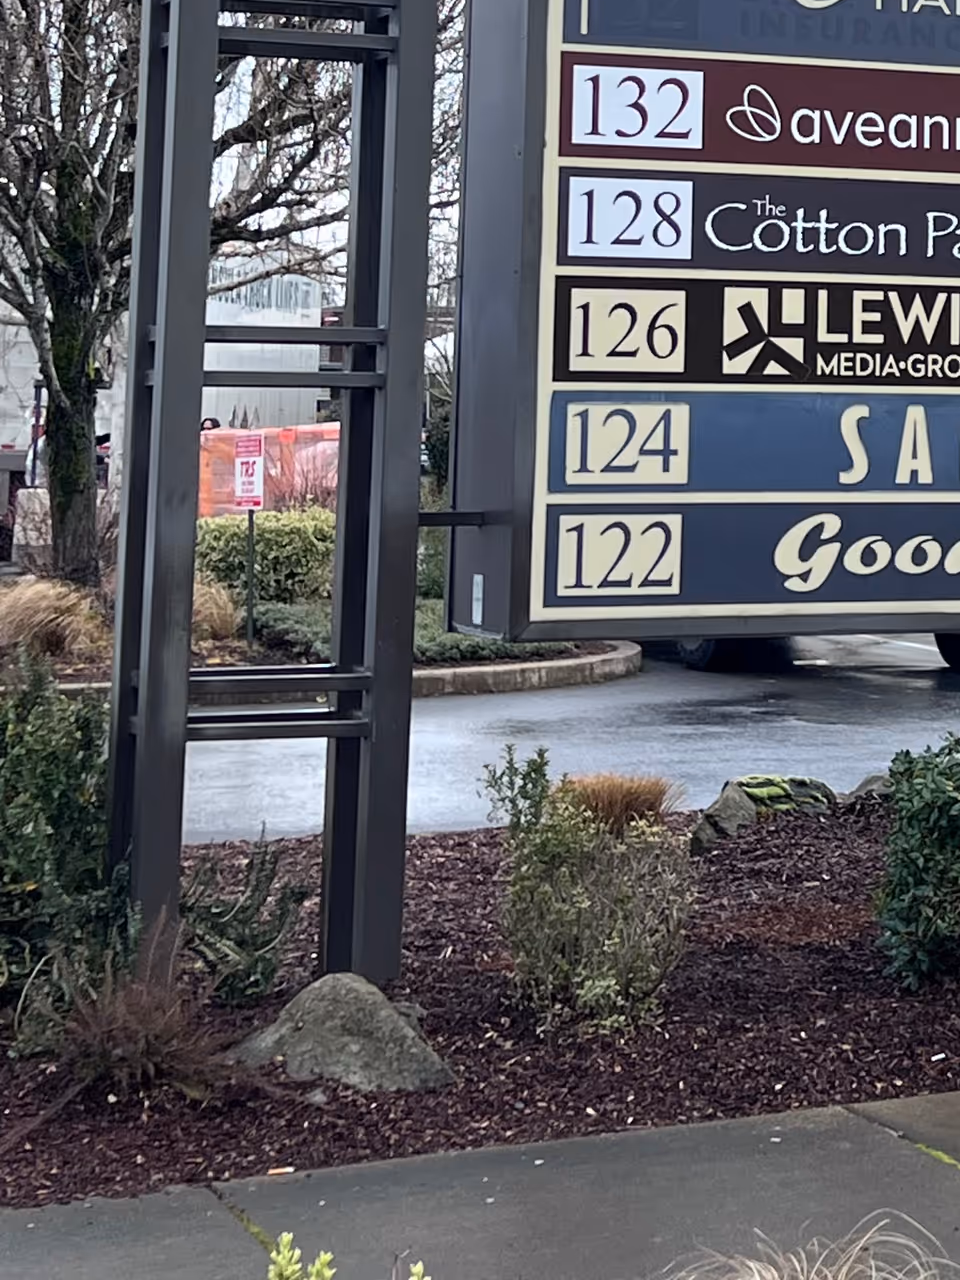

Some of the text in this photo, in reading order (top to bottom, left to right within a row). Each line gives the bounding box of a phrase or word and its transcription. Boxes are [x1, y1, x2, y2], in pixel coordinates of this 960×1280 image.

[585, 75, 691, 139] 132
[581, 189, 681, 247] 128
[705, 203, 907, 255] Cotton
[752, 195, 785, 216] The
[577, 302, 678, 359] 126
[573, 409, 678, 473] 124
[564, 521, 673, 589] 122
